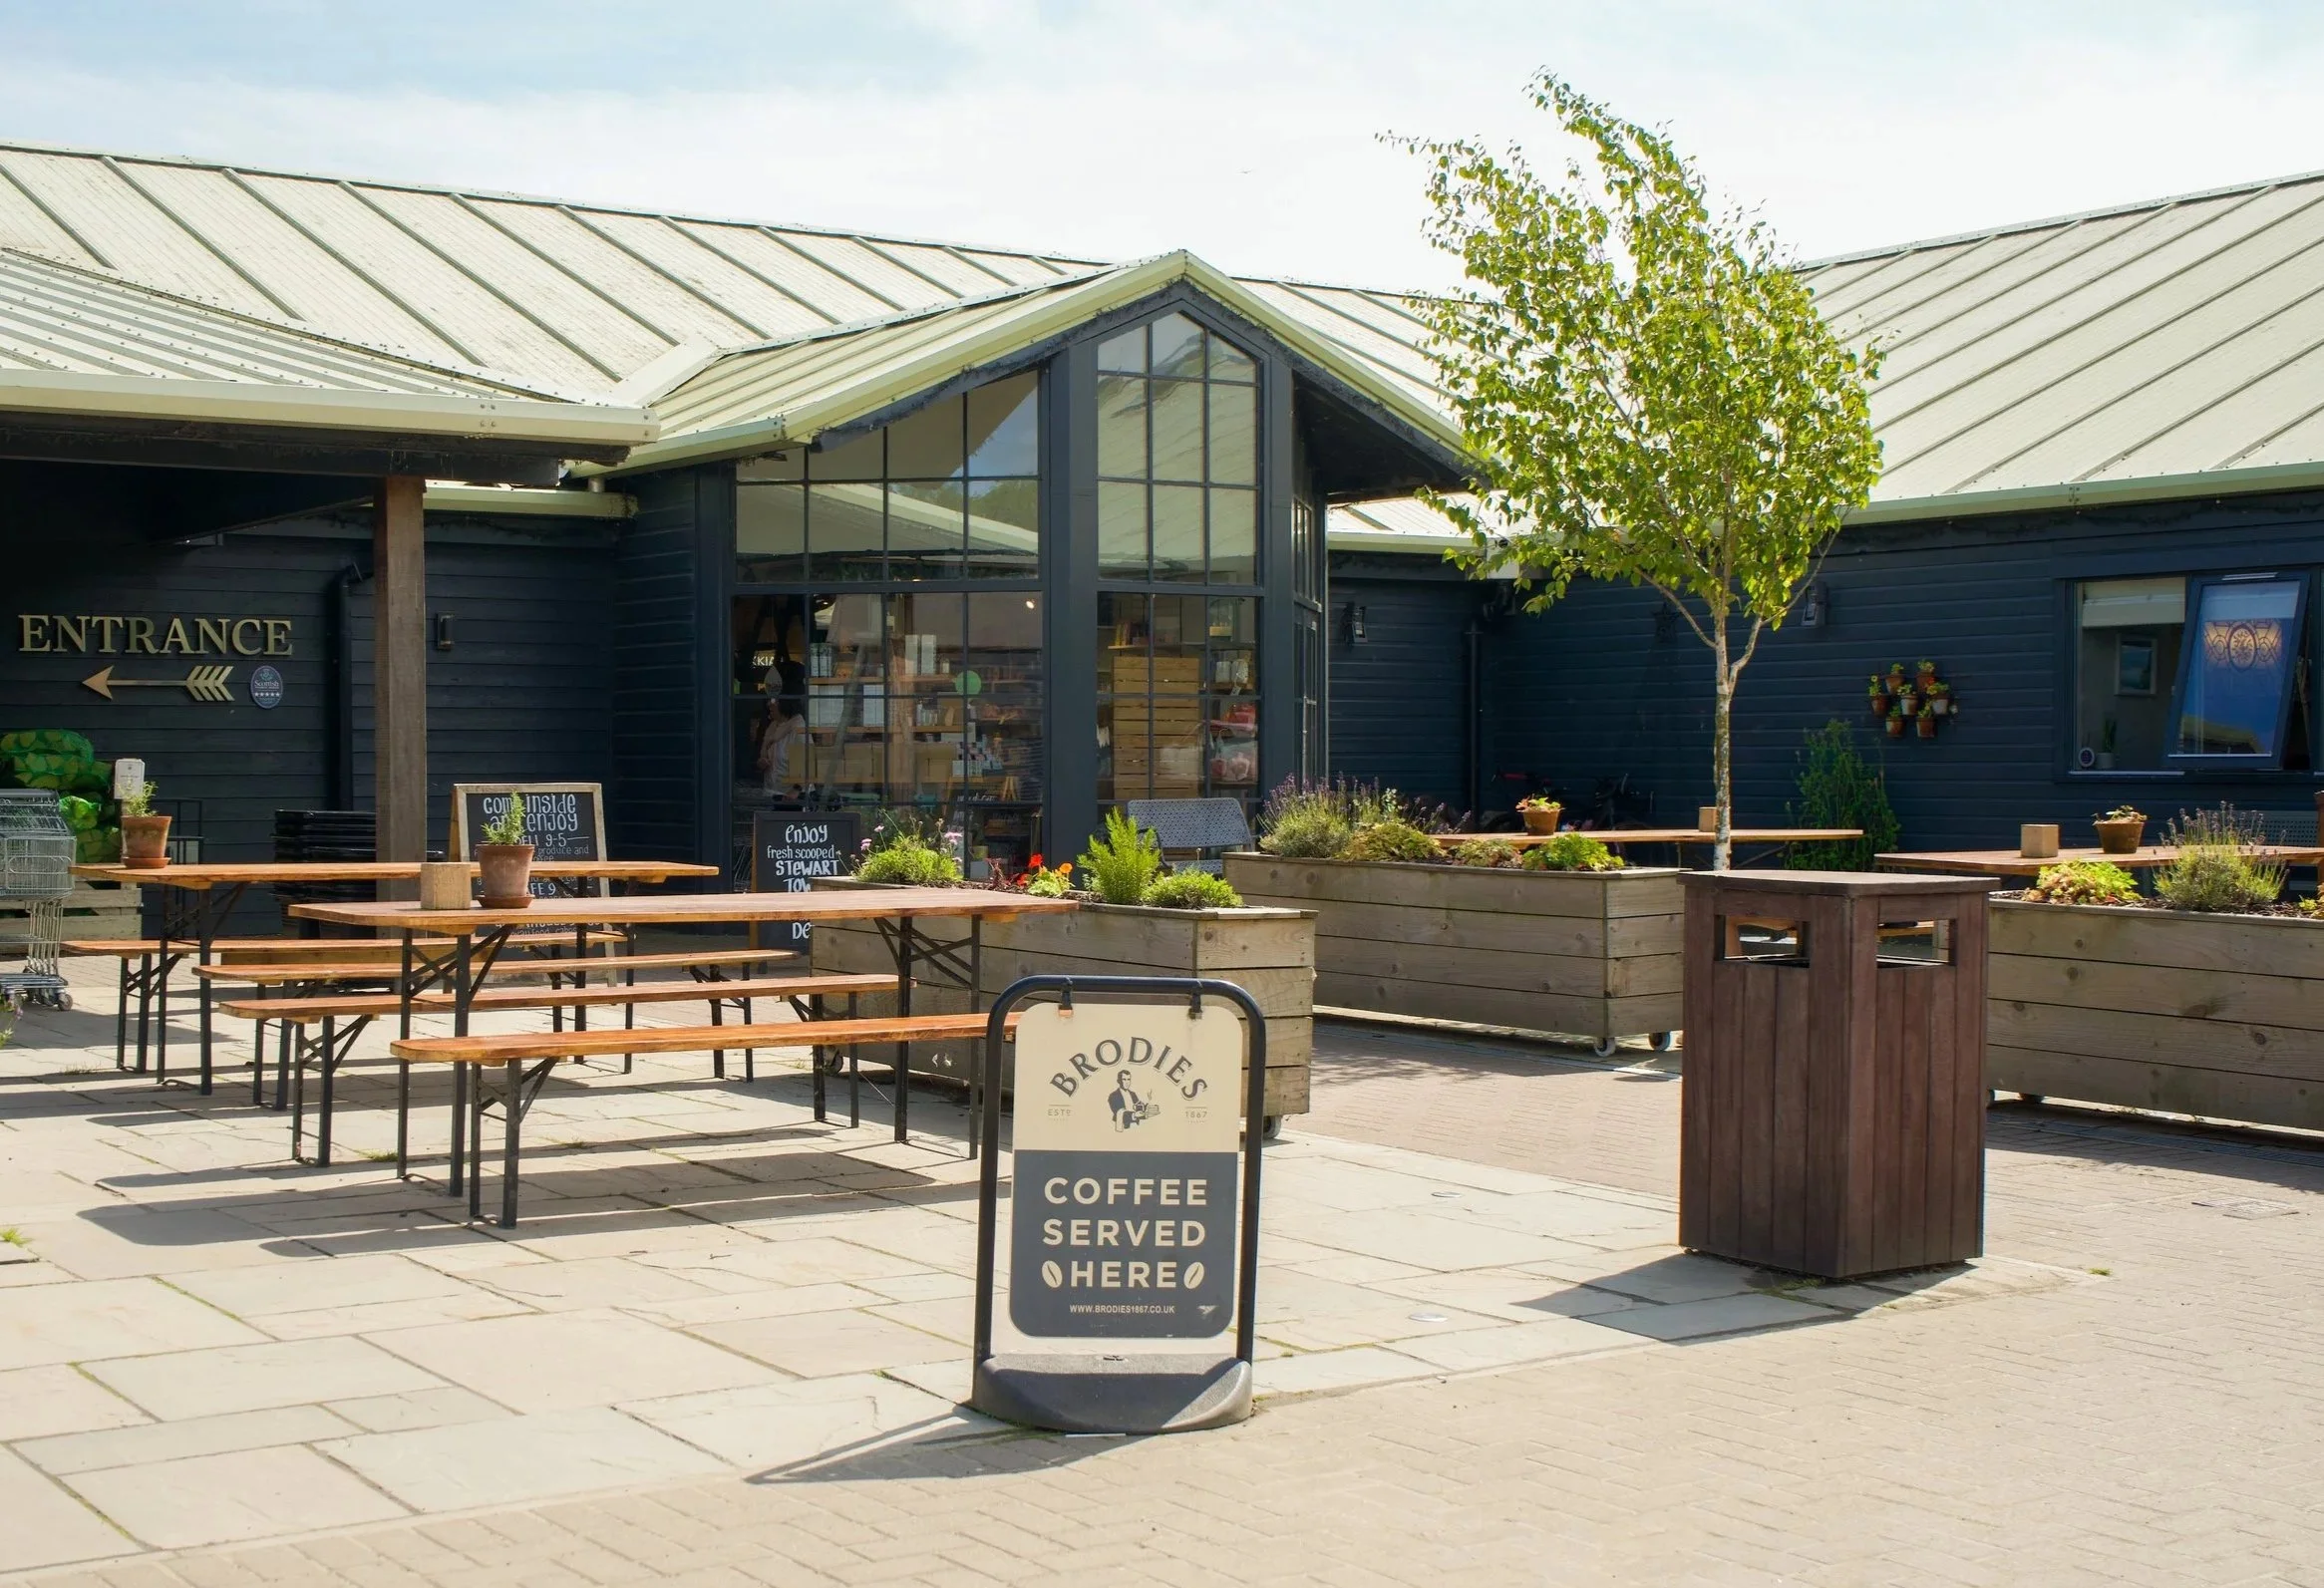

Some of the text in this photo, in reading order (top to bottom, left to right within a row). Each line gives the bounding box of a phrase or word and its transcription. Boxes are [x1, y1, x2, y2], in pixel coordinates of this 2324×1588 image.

[18, 614, 293, 656] ENTRANCE
[484, 794, 576, 814] com inside
[526, 812, 578, 832] enjoy
[545, 832, 567, 847] 9-5
[785, 822, 829, 844] enjoy
[573, 843, 590, 855] and
[767, 844, 835, 860] fresh scooped
[782, 877, 812, 893] TOW
[1049, 1036, 1208, 1101] BRODIES
[1184, 1111, 1208, 1119] 1867
[1043, 1176, 1208, 1206] COFFEE
[1042, 1218, 1206, 1247] SERVED
[1070, 1261, 1177, 1289] HERE
[1069, 1304, 1176, 1315] WWW.BRODIES1867.CO.UK
